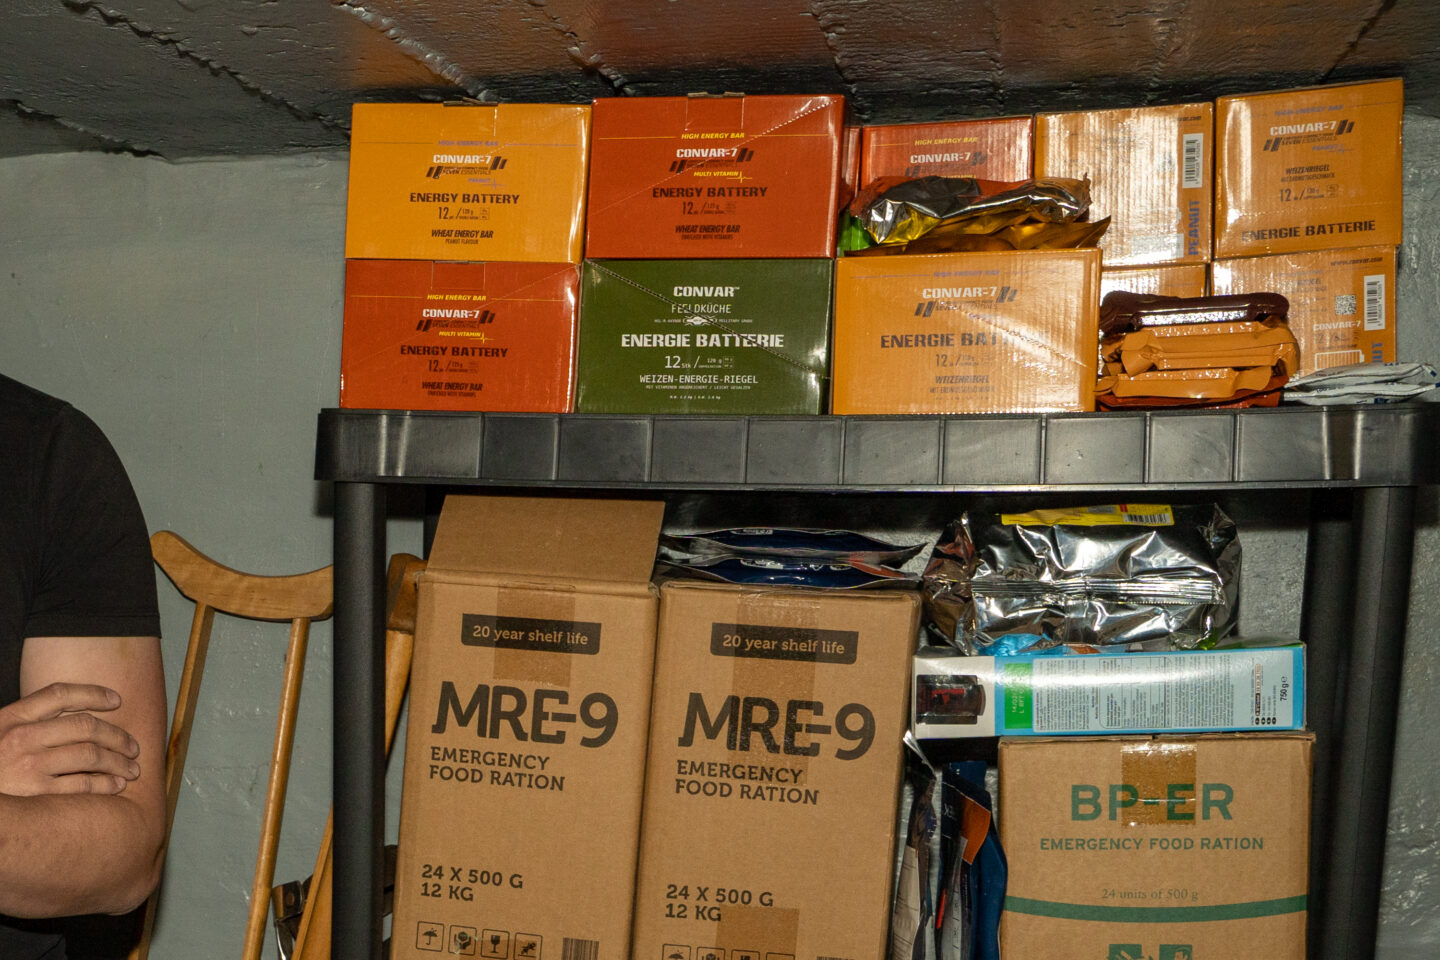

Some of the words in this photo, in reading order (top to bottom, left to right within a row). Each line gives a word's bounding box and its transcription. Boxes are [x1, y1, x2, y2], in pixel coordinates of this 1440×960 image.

[933, 137, 961, 145] ENERGY
[409, 192, 459, 203] ENERGY
[461, 193, 520, 205] BATTERY
[652, 187, 703, 198] ENERGY
[706, 186, 768, 198] BATTERY
[1279, 188, 1292, 202] 12
[438, 206, 449, 220] 12
[682, 201, 694, 215] 12
[431, 229, 454, 238] WHEAT
[454, 229, 479, 238] ENERGY
[479, 230, 494, 239] BAR
[675, 224, 699, 233] WHEAT
[699, 224, 726, 233] ENERGY
[726, 224, 741, 233] BAR
[1187, 199, 1201, 256] PEANUT
[1241, 226, 1300, 241] ENERGIE
[1305, 220, 1376, 236] BATTERIE
[620, 333, 691, 348] ENERGIE
[695, 333, 784, 348] BATTERIE
[880, 333, 955, 349] ENERGIE
[400, 345, 448, 356] ENERGY
[451, 346, 508, 358] BATTERY
[428, 359, 439, 372] 12
[664, 355, 681, 369] 12
[421, 381, 443, 390] WHEAT
[444, 381, 469, 391] ENERGY
[469, 382, 483, 391] BAR
[639, 374, 759, 384] WEIZEN-ENERGIE-RIEGEL
[472, 624, 490, 638] 20
[493, 626, 525, 642] year
[528, 629, 563, 643] shelf
[566, 631, 589, 645] life
[722, 633, 741, 648] 20
[744, 636, 778, 651] year
[781, 638, 819, 653] shelf
[821, 640, 845, 655] life
[1279, 688, 1288, 702] 750
[430, 680, 619, 748] MRE-9
[676, 691, 876, 761] MRE-9
[430, 745, 550, 771] EMERGENCY
[429, 764, 484, 784] FOOD
[489, 769, 566, 791] RATION
[676, 759, 804, 784] EMERGENCY
[675, 778, 733, 798] FOOD
[739, 783, 820, 805] RATION
[1070, 782, 1235, 822] BP-ER
[1039, 837, 1143, 851] EMERGENCY
[1149, 837, 1195, 850] FOOD
[1199, 836, 1264, 850] RATION
[421, 863, 444, 880] 24
[449, 865, 463, 883] X
[467, 868, 503, 886] 500
[509, 873, 524, 889] G
[420, 881, 442, 898] 12
[448, 884, 474, 902] KG
[665, 883, 690, 900] 24
[696, 886, 710, 901] X
[715, 887, 753, 905] 500
[759, 890, 774, 907] G
[1101, 888, 1116, 900] 24
[1118, 888, 1147, 900] units
[1149, 888, 1163, 900] of
[1166, 888, 1185, 900] 500
[1190, 890, 1199, 902] g
[664, 902, 688, 919] 12
[695, 905, 722, 922] KG
